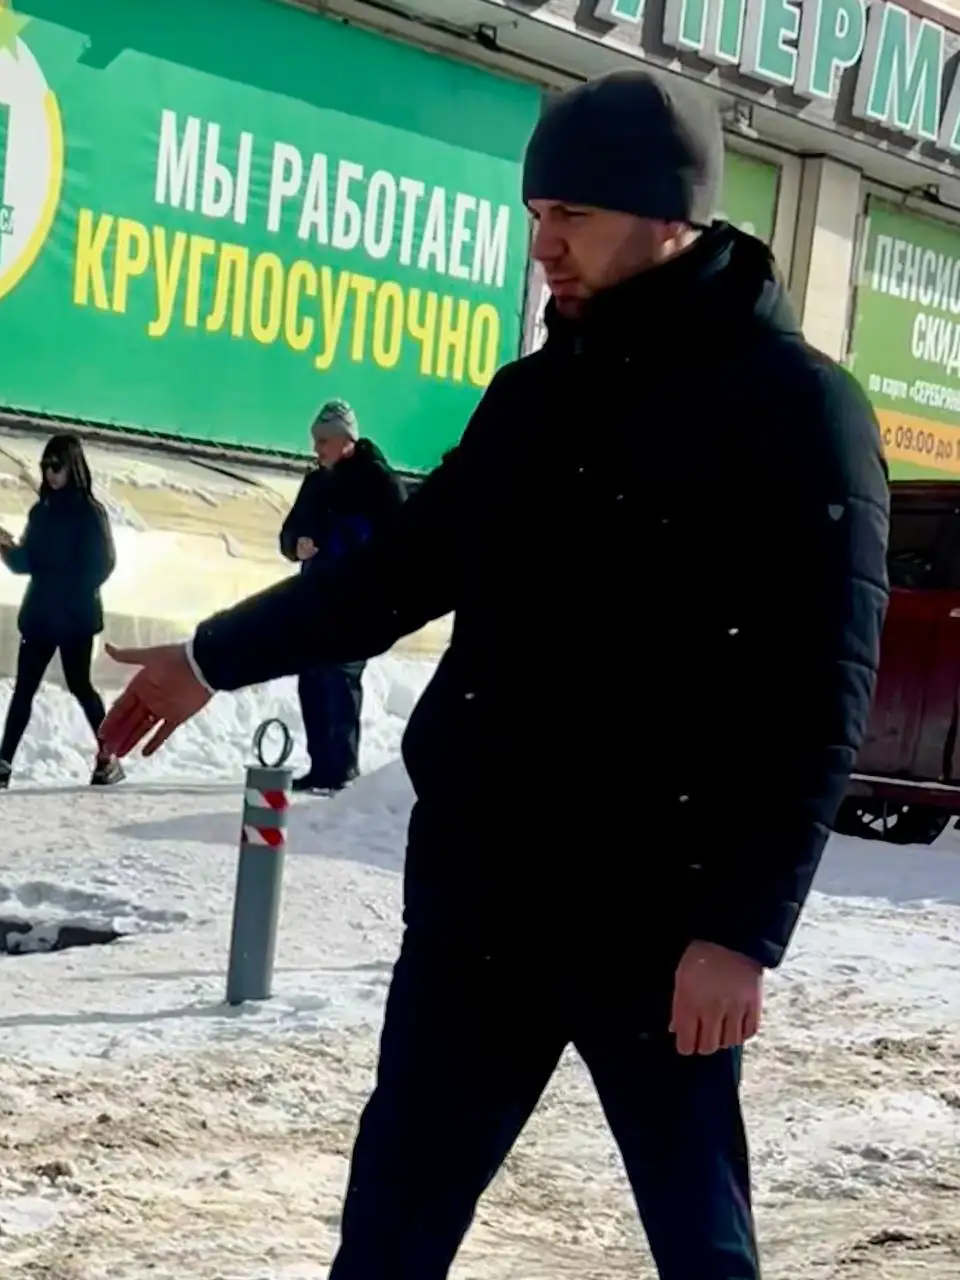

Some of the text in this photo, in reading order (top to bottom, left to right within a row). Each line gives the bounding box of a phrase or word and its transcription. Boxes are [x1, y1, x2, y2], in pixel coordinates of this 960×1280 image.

[154, 109, 511, 289] МЫ РАБОТАЕМ
[73, 208, 501, 388] КРУГЛОСУТОЧНО
[895, 425, 935, 455] 09.00
